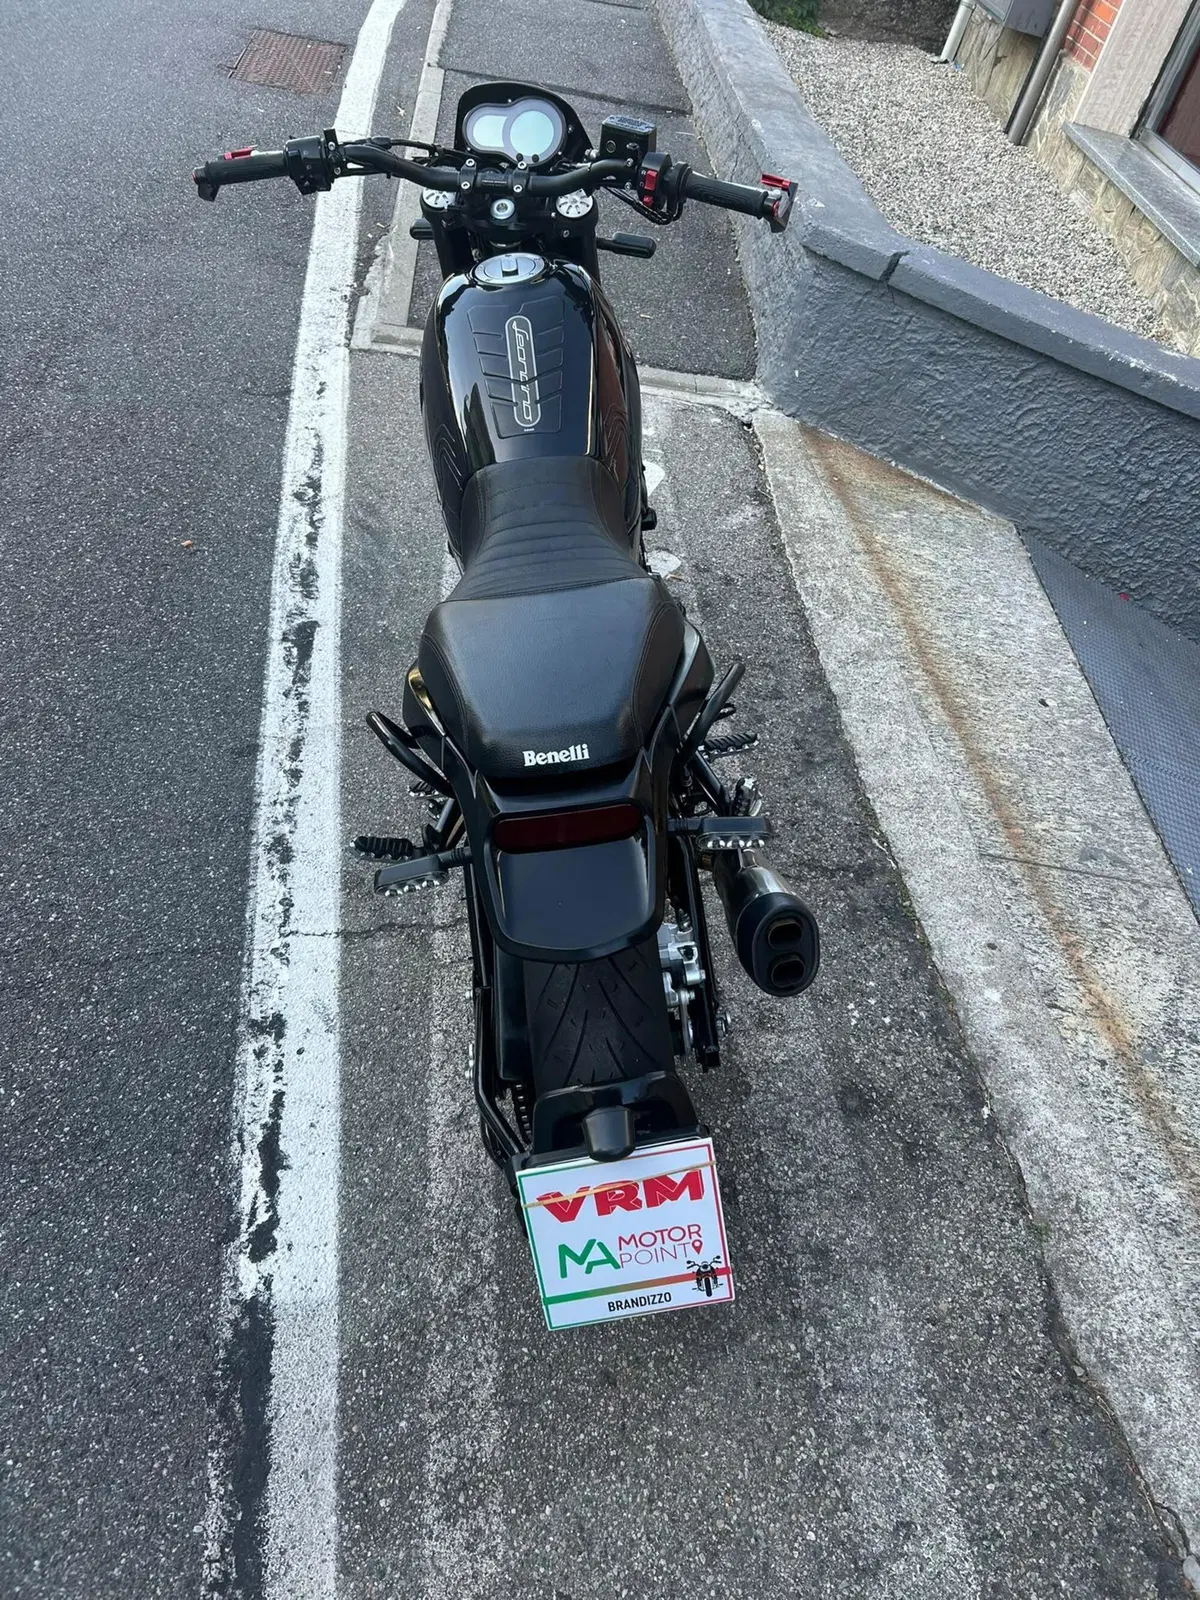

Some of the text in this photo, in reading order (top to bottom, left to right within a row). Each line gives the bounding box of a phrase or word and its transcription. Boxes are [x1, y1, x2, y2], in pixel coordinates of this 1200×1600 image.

[523, 743, 590, 767] Benelli
[536, 1168, 705, 1223] VRM
[618, 1223, 702, 1251] MOTOR
[619, 1242, 690, 1268] POINT
[607, 1291, 672, 1313] BRANDIZZO
